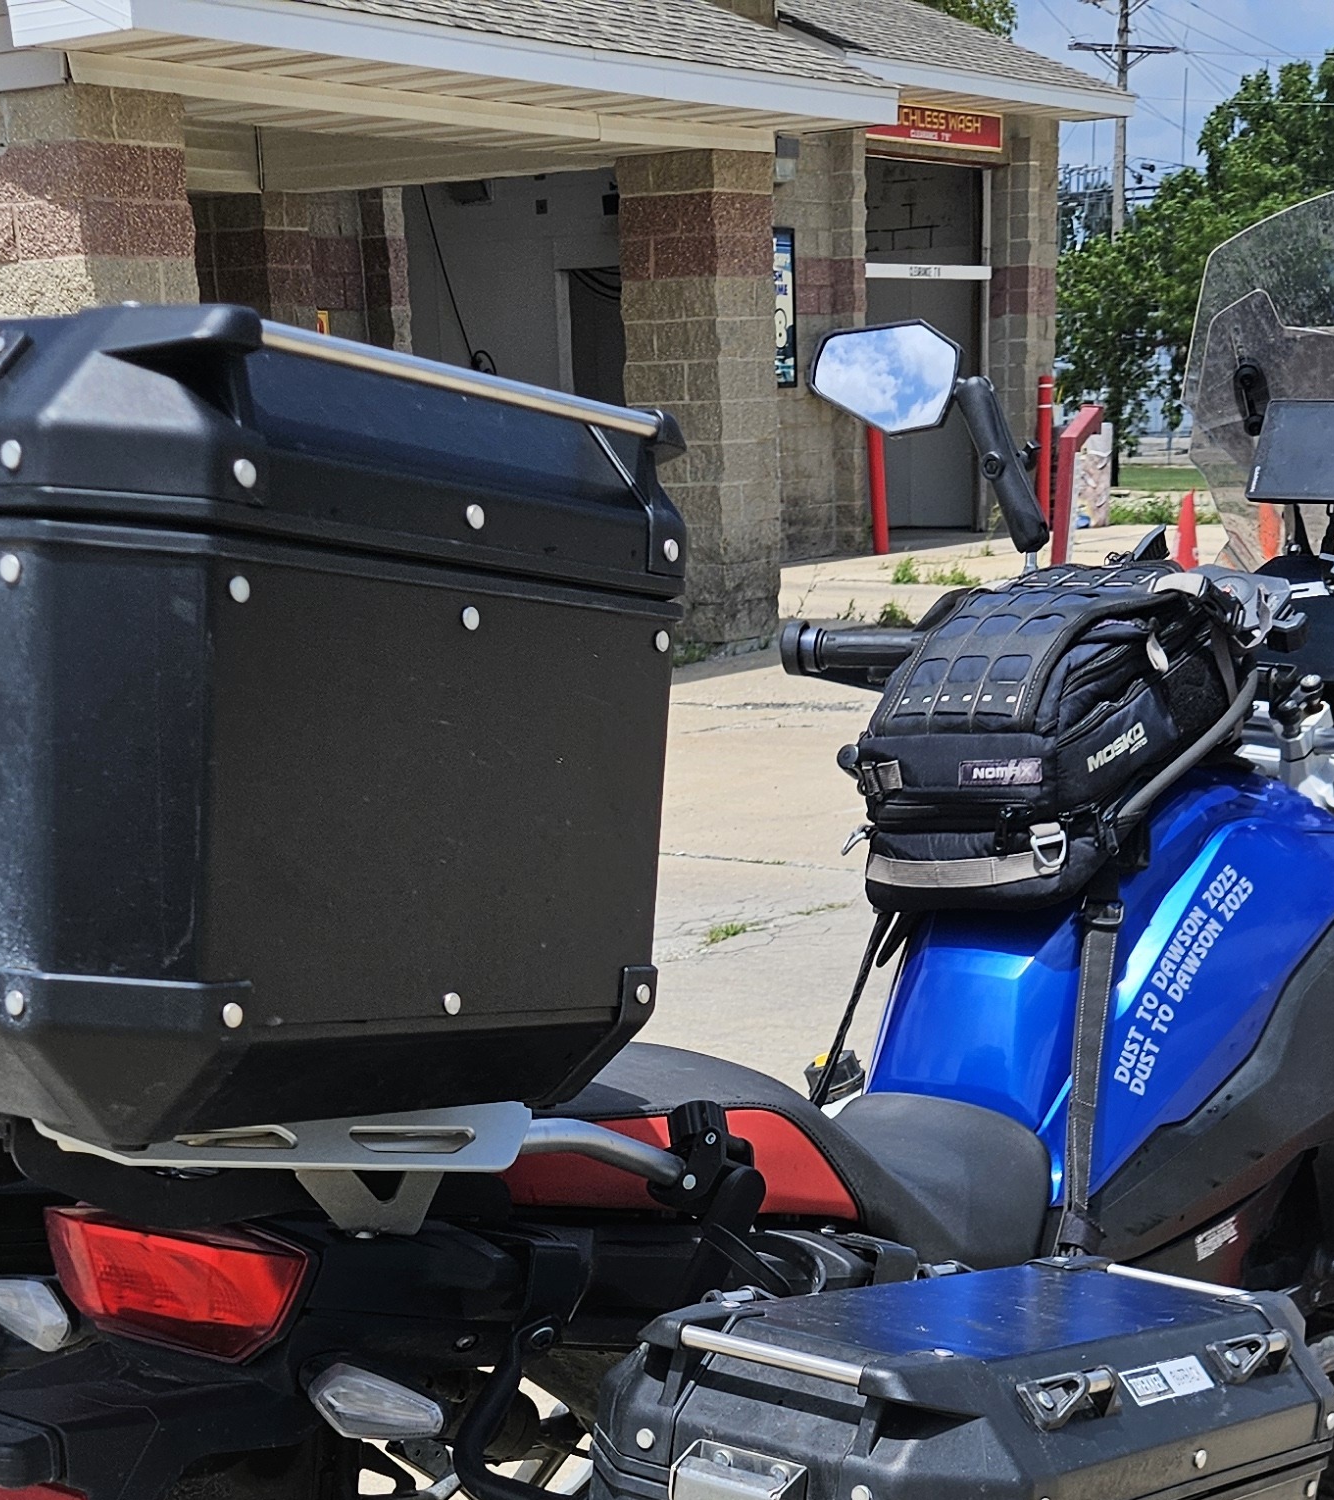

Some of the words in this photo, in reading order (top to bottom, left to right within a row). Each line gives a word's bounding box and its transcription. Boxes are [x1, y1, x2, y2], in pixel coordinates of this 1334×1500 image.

[948, 114, 982, 134] WASH
[1086, 721, 1146, 773] MOSKO
[1113, 1025, 1145, 1084] DUST
[1135, 991, 1159, 1022] TO
[1150, 905, 1208, 990] DAWSON
[1201, 864, 1238, 910] 2025
[1129, 1037, 1160, 1096] DUST
[1151, 1003, 1175, 1034] TO
[1166, 917, 1224, 1003] DAWSON
[1217, 876, 1254, 922] 2025
